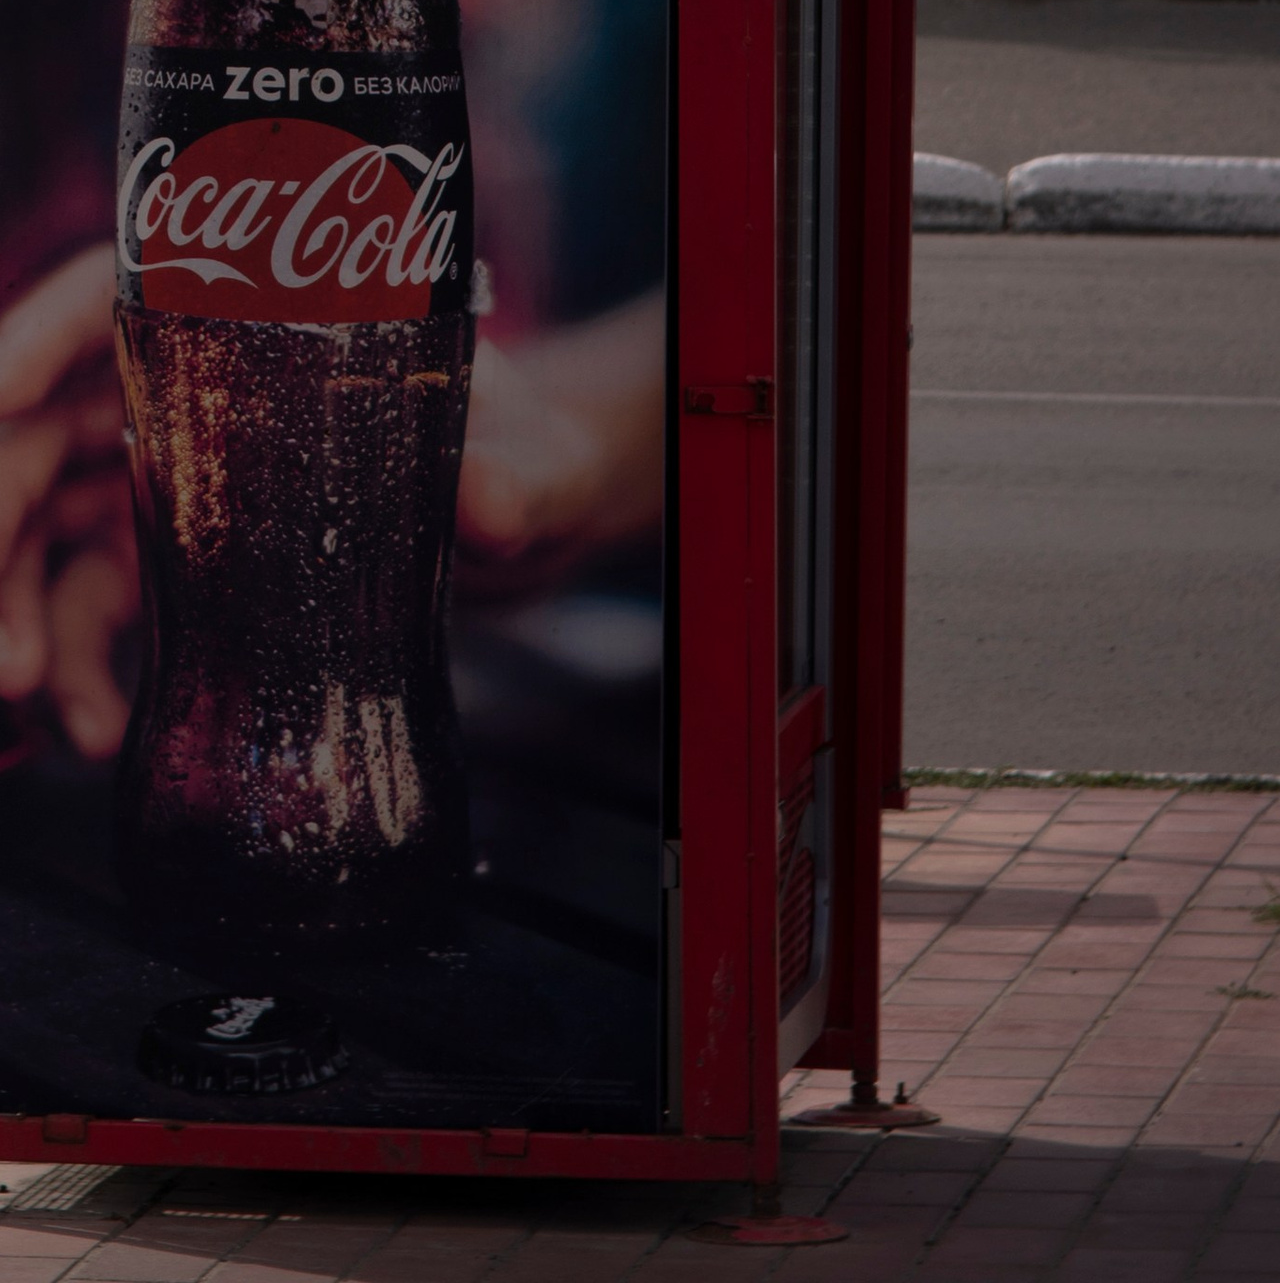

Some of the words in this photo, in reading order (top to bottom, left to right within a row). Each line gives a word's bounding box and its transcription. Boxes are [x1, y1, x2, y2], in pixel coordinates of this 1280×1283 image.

[144, 67, 215, 92] САХАРА
[223, 66, 345, 103] zero
[354, 77, 393, 95] БЕЗ
[120, 137, 465, 290] Coca-Cola
